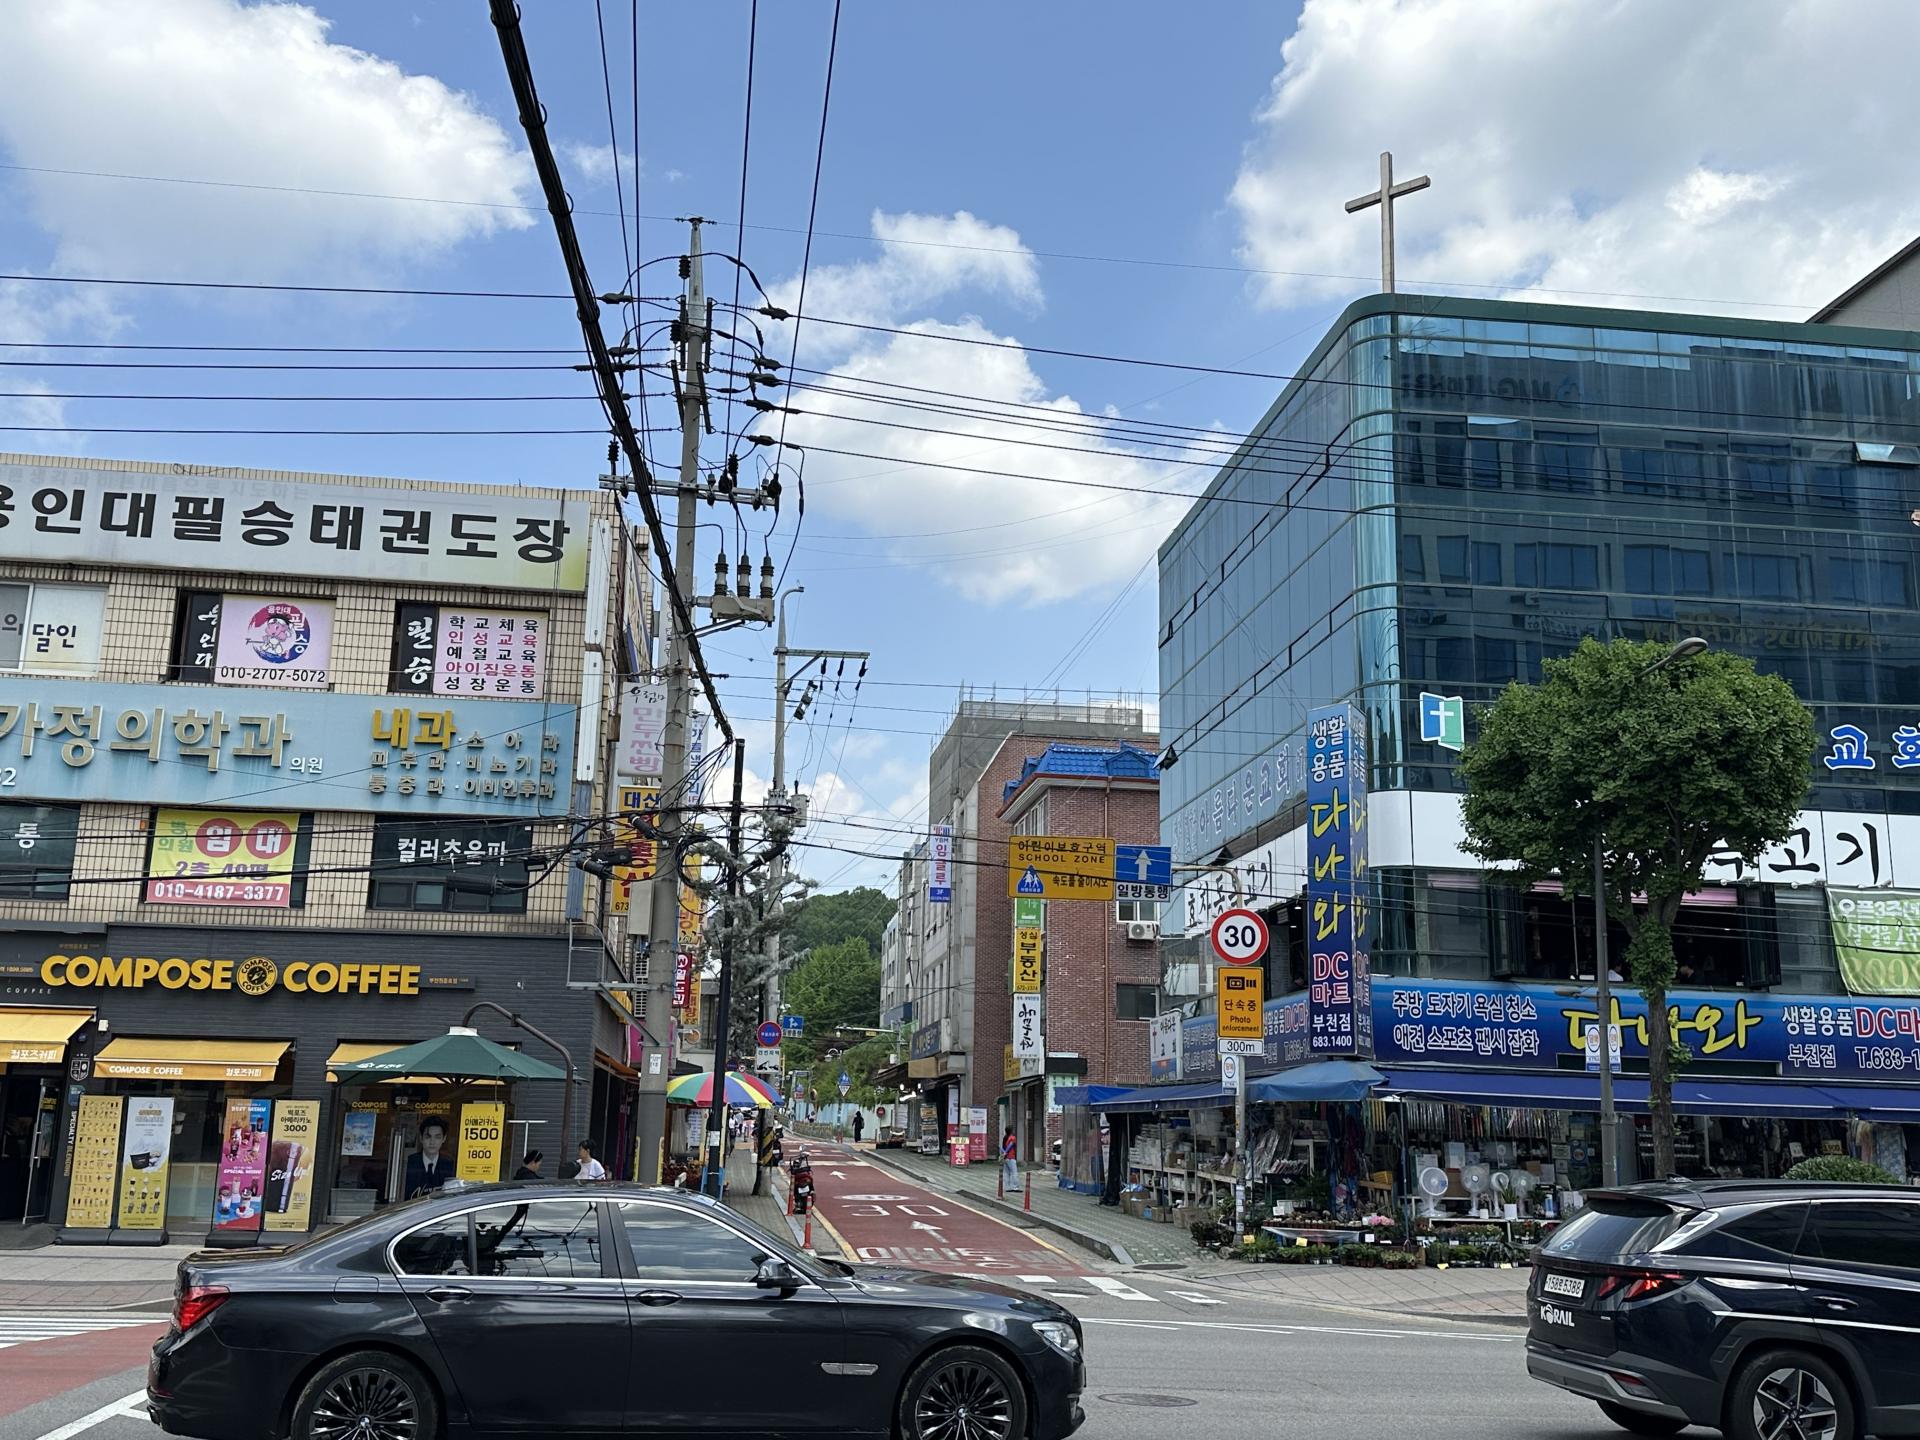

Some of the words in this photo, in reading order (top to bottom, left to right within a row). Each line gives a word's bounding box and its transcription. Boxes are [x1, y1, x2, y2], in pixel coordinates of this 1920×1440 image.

[267, 605, 292, 614] 용인대
[449, 616, 539, 633] 학교체육
[33, 624, 76, 652] 달인
[448, 630, 537, 648] 인성교육
[404, 617, 434, 684] 필승
[446, 646, 537, 663] 예절교육
[220, 666, 326, 682] 010-2707-5072
[444, 676, 536, 694] 성장운동
[0, 702, 292, 772] 가정의학과
[289, 757, 323, 774] 의원
[372, 708, 457, 750] 내과
[1311, 715, 1346, 749] 생활
[1311, 750, 1346, 782] 용품
[463, 777, 556, 799] 이비인후과
[397, 838, 509, 866] 컬러초음파
[1018, 841, 1106, 854] 어린이보호구역
[1018, 853, 1066, 862] SCHOOL
[1074, 855, 1105, 864] ZONE
[1310, 786, 1347, 942] 다나와
[1052, 875, 1075, 887] 속도를
[154, 882, 284, 901] 010-4187-3377
[1117, 884, 1169, 899] 일방통행
[1224, 925, 1256, 947] 30
[241, 959, 274, 974] COMPOSE
[1020, 942, 1038, 982] 부동산
[1312, 952, 1349, 982] DC
[40, 954, 235, 991] COMPOSE
[283, 961, 421, 995] COFFEE
[242, 981, 271, 992] COFFEE
[1312, 982, 1351, 1008] 마트
[1224, 1000, 1257, 1011] 단속중
[1393, 991, 1422, 1018] 주방
[1427, 991, 1471, 1018] 도자기
[1474, 993, 1504, 1021] 욕실
[1506, 994, 1537, 1022] 청소
[1230, 1015, 1251, 1023] Photo
[1312, 1013, 1351, 1033] 부천점
[1782, 1005, 1854, 1037] 생활용품
[1227, 1041, 1255, 1051] 300m
[1312, 1035, 1352, 1048] 683.1400
[1393, 1023, 1425, 1052] 애견
[1427, 1025, 1473, 1052] 스포츠
[1475, 1027, 1506, 1055] 팬시
[1508, 1028, 1539, 1056] 잡화
[1788, 1044, 1836, 1068] 부천점
[109, 1065, 151, 1075] COMPOSE
[153, 1067, 184, 1076] COFFEE
[351, 1101, 388, 1109] COMPOSE
[283, 1124, 308, 1132] 3000
[464, 1118, 499, 1126] 아메리카노
[464, 1127, 499, 1140] 1500
[467, 1150, 492, 1159] 1800
[841, 1204, 950, 1217] 30
[1540, 1303, 1575, 1327] KORAIL
